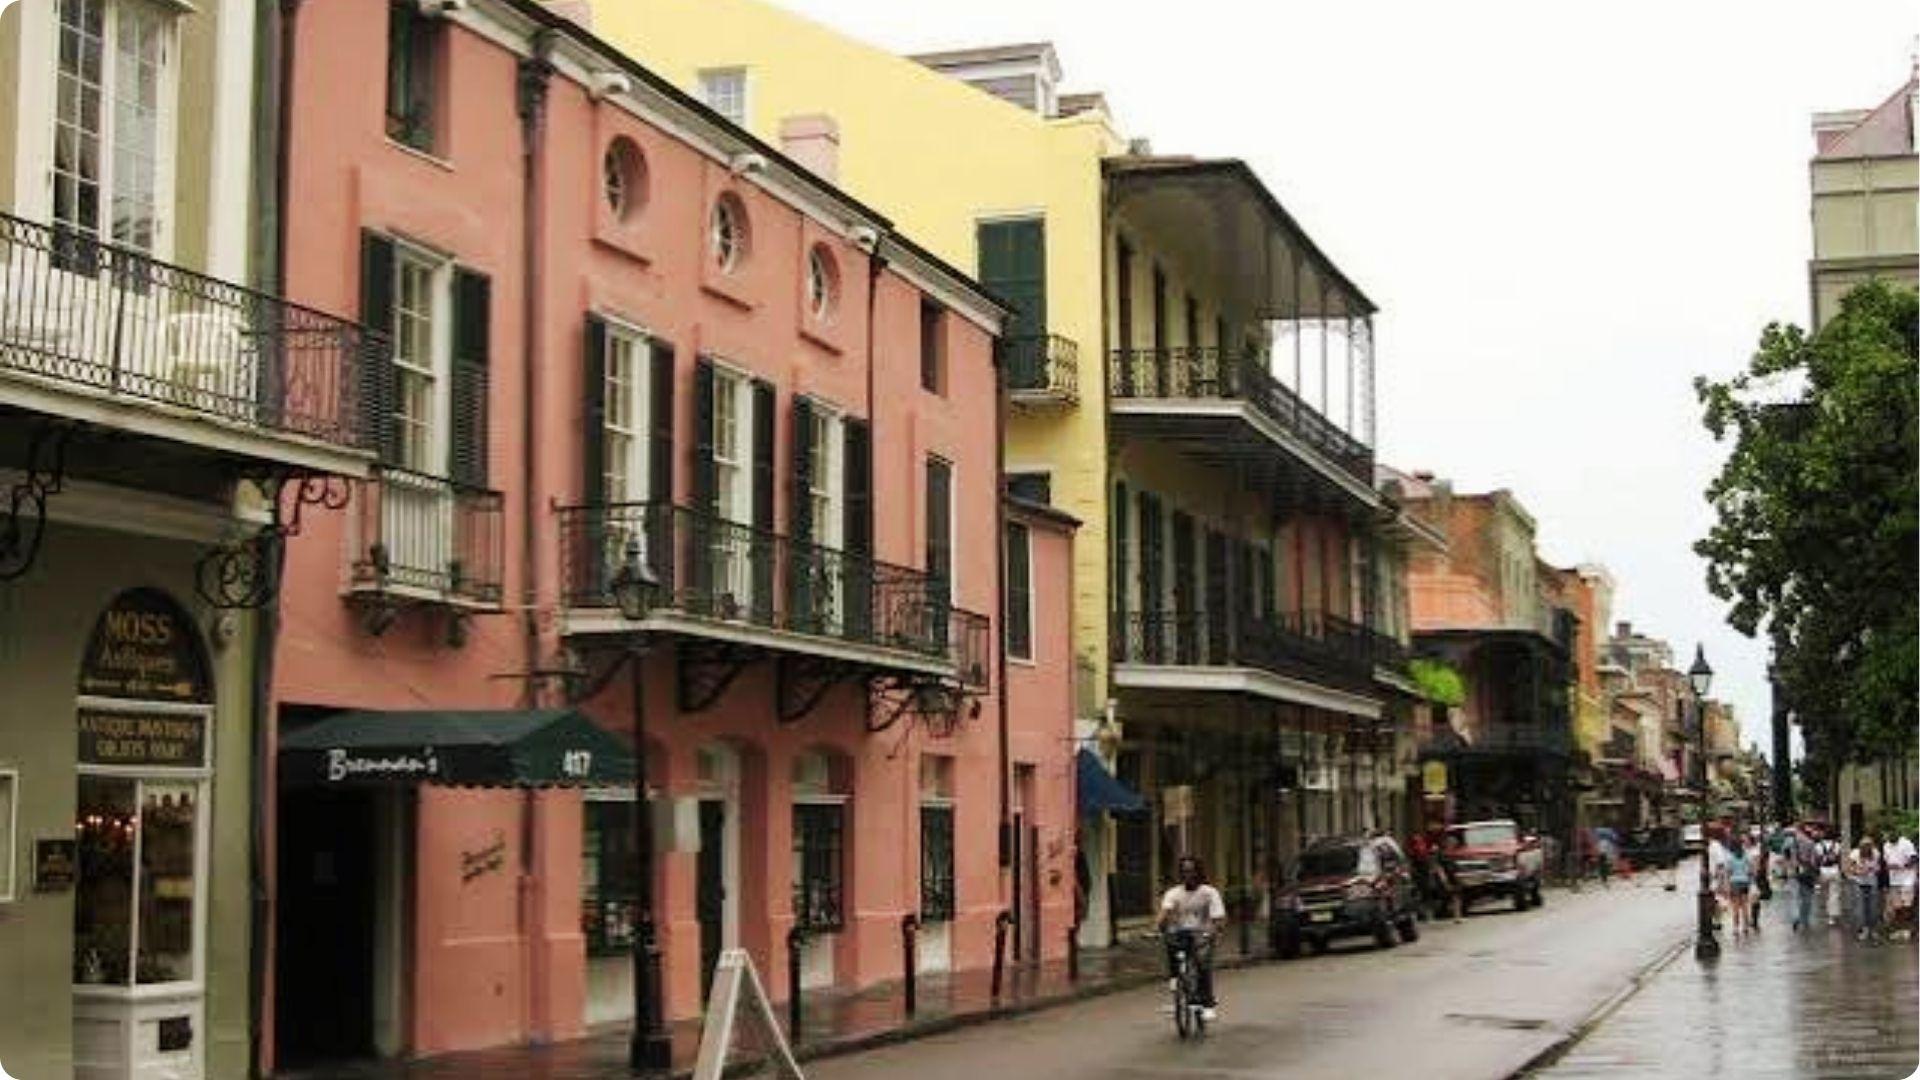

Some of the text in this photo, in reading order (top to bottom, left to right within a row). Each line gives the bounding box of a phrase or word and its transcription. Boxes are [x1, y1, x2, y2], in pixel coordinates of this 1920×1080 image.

[107, 609, 170, 645] MOSS
[328, 747, 438, 781] Brennan's
[562, 750, 592, 778] 417
